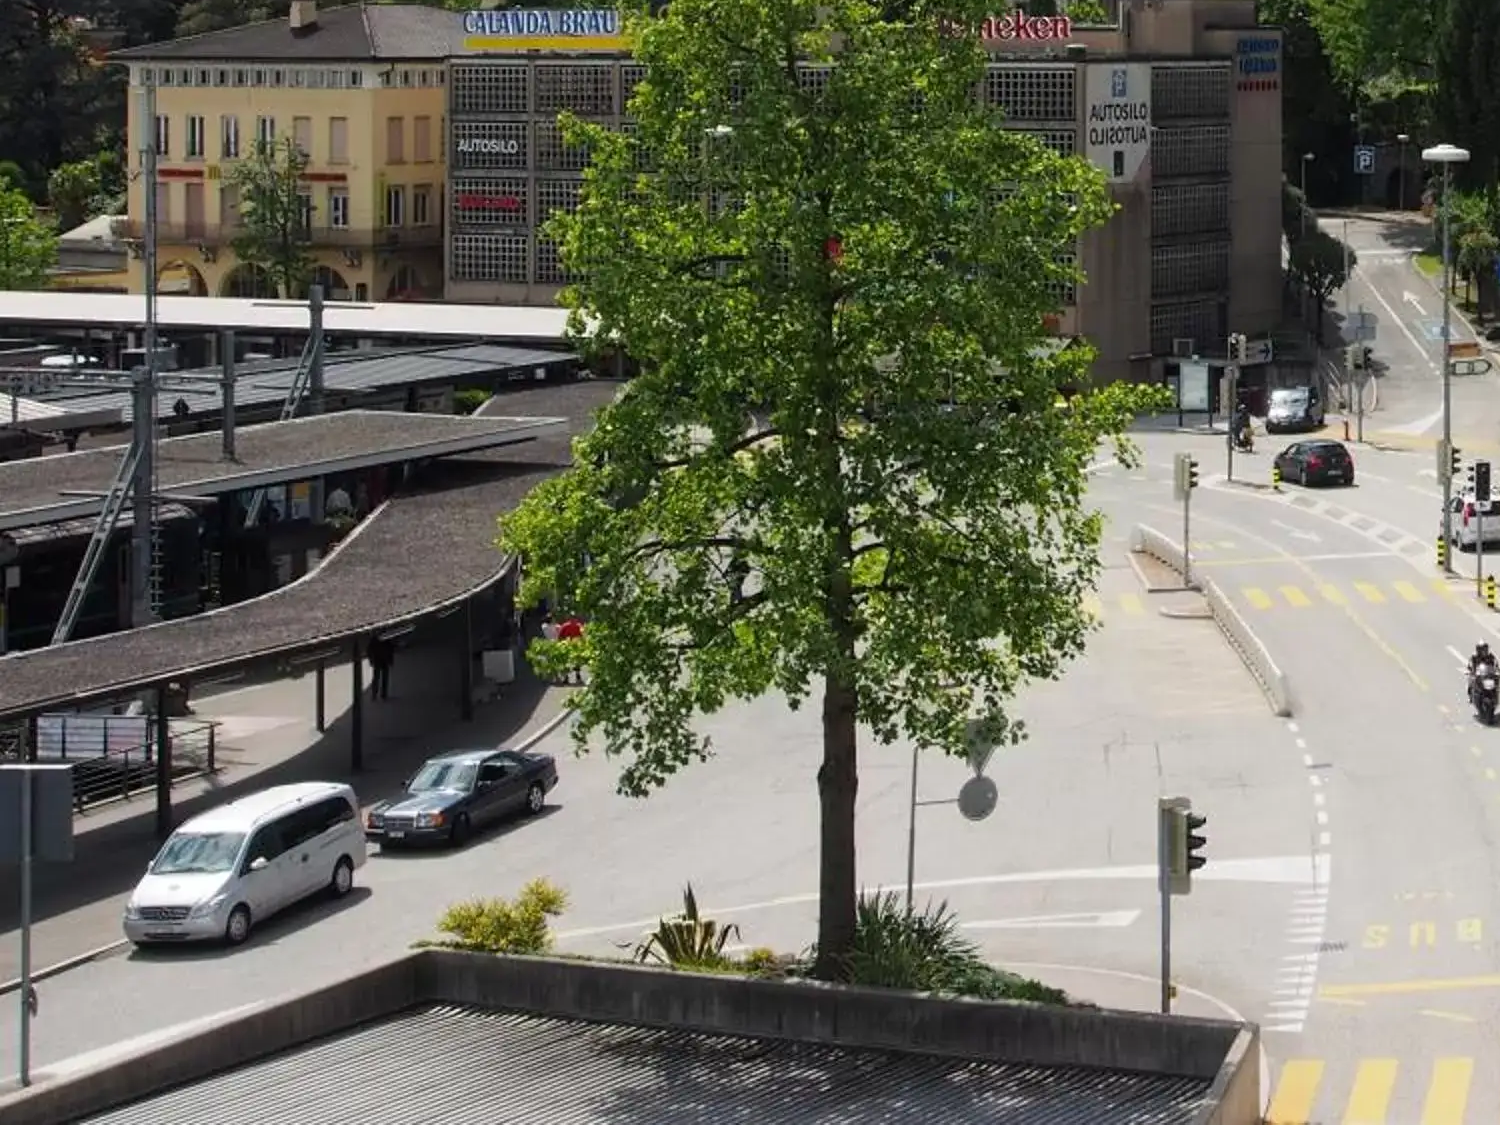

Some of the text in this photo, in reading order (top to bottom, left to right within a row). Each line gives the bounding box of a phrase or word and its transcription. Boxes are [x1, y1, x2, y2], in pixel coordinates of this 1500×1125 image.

[463, 10, 552, 35] CALANDA
[1089, 102, 1148, 122] AUTOSILO
[457, 138, 519, 154] AUTOSILO
